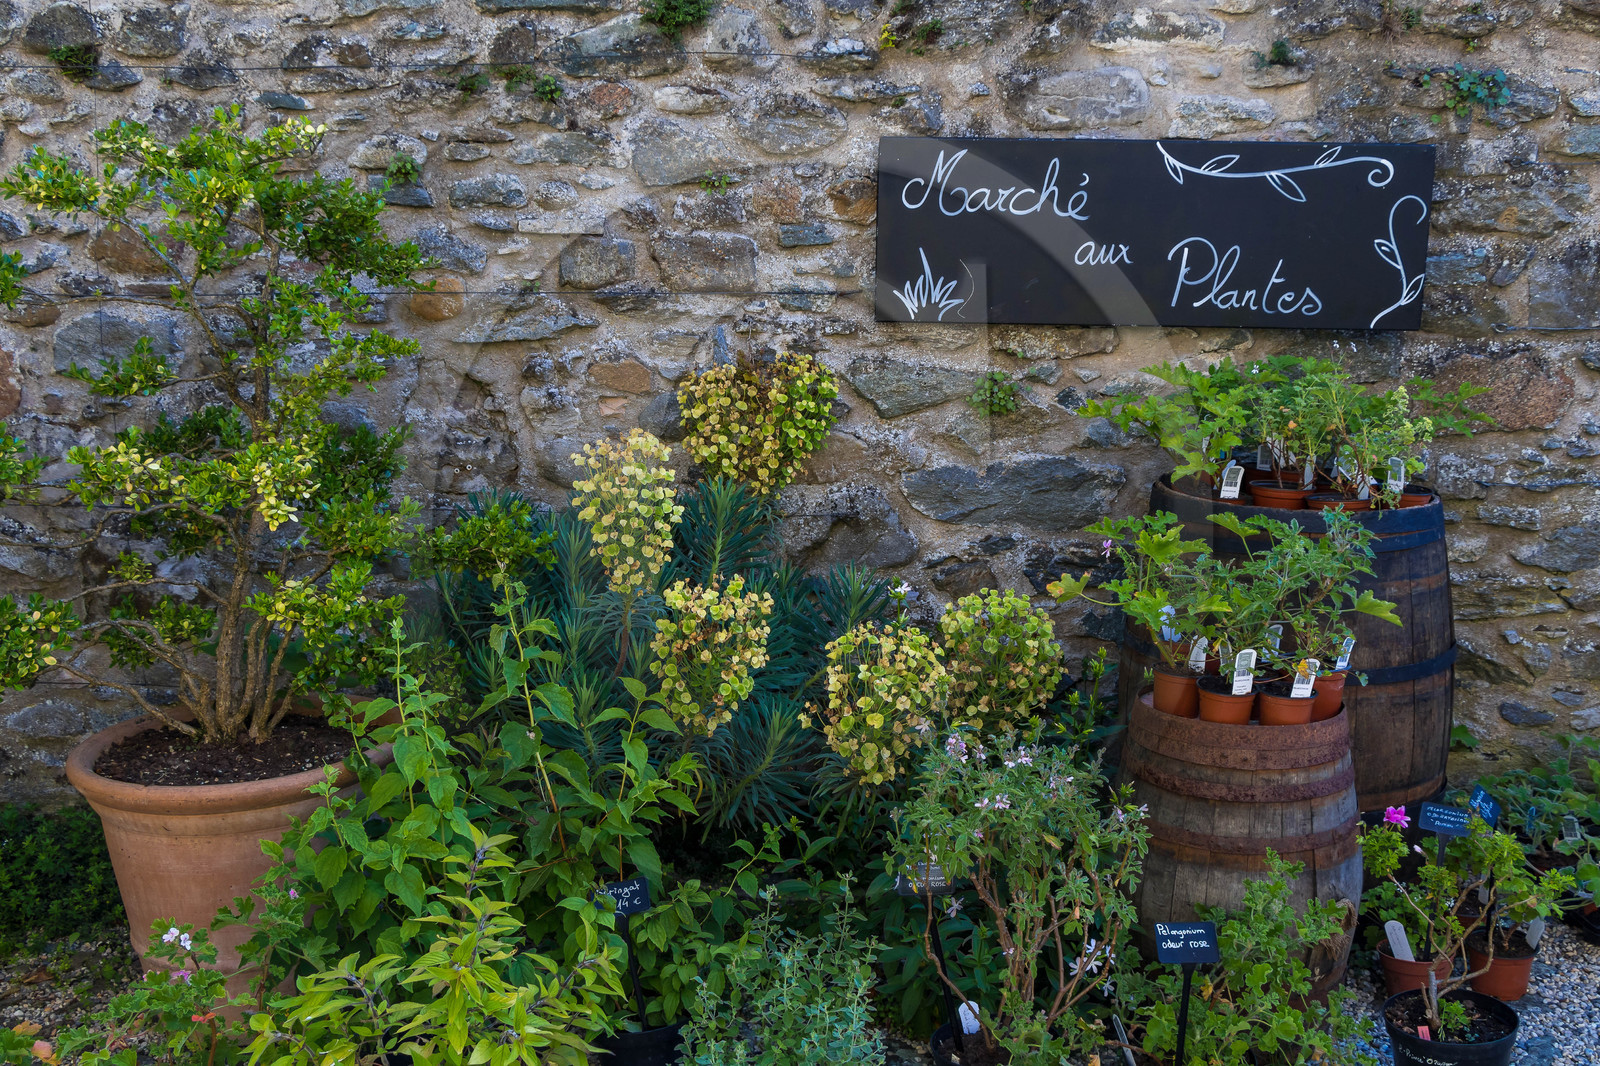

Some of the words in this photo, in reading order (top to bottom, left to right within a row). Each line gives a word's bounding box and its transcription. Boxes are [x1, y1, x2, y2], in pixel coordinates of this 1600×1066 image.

[902, 148, 1089, 220] Marché
[1074, 240, 1134, 265] aux
[1167, 236, 1322, 315] Plantes
[617, 898, 629, 910] 14
[1162, 939, 1184, 949] odeur
[1189, 940, 1210, 948] rose
